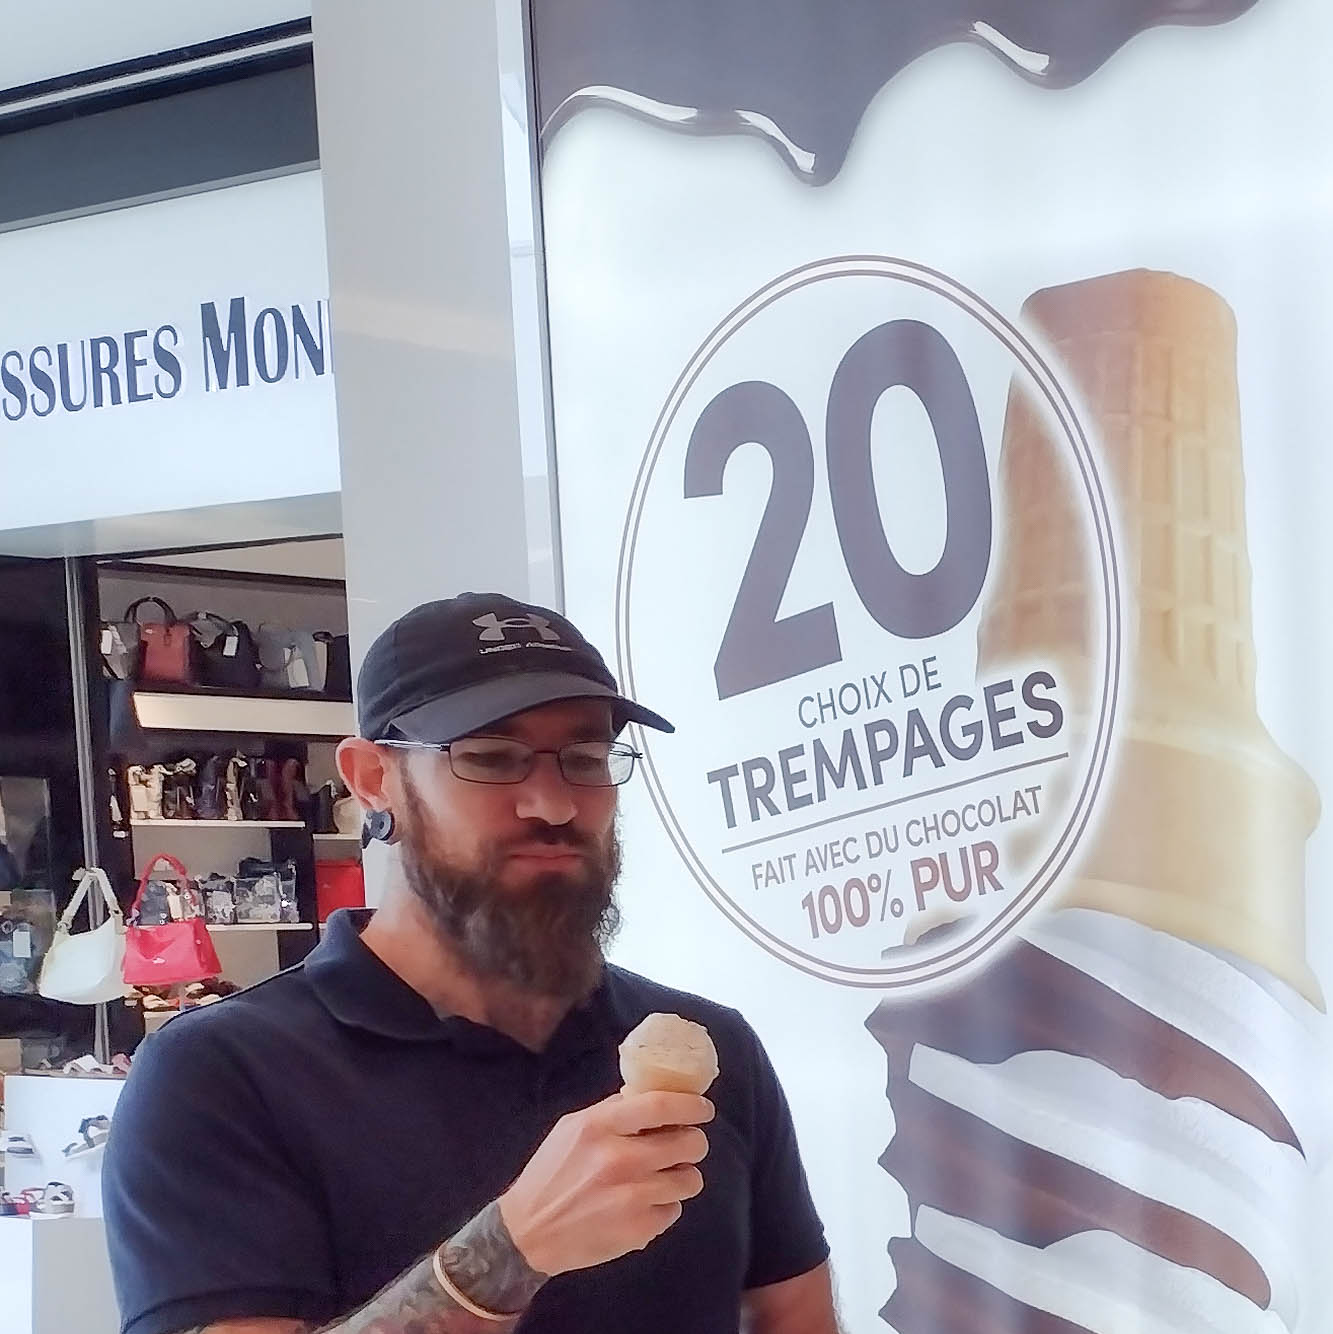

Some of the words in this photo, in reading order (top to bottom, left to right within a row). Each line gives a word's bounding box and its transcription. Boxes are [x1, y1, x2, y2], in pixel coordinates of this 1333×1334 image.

[200, 296, 333, 392] MON
[684, 319, 992, 701] 20
[798, 671, 893, 729] CHOIX
[899, 656, 942, 699] DE
[706, 670, 1064, 829] TREMPAGES
[752, 853, 798, 890] FAIT
[804, 836, 858, 877] AVEC
[864, 825, 899, 859] DU
[905, 785, 1043, 847] CHOCOLAT
[801, 868, 904, 939] 100%
[909, 839, 1005, 912] PUR
